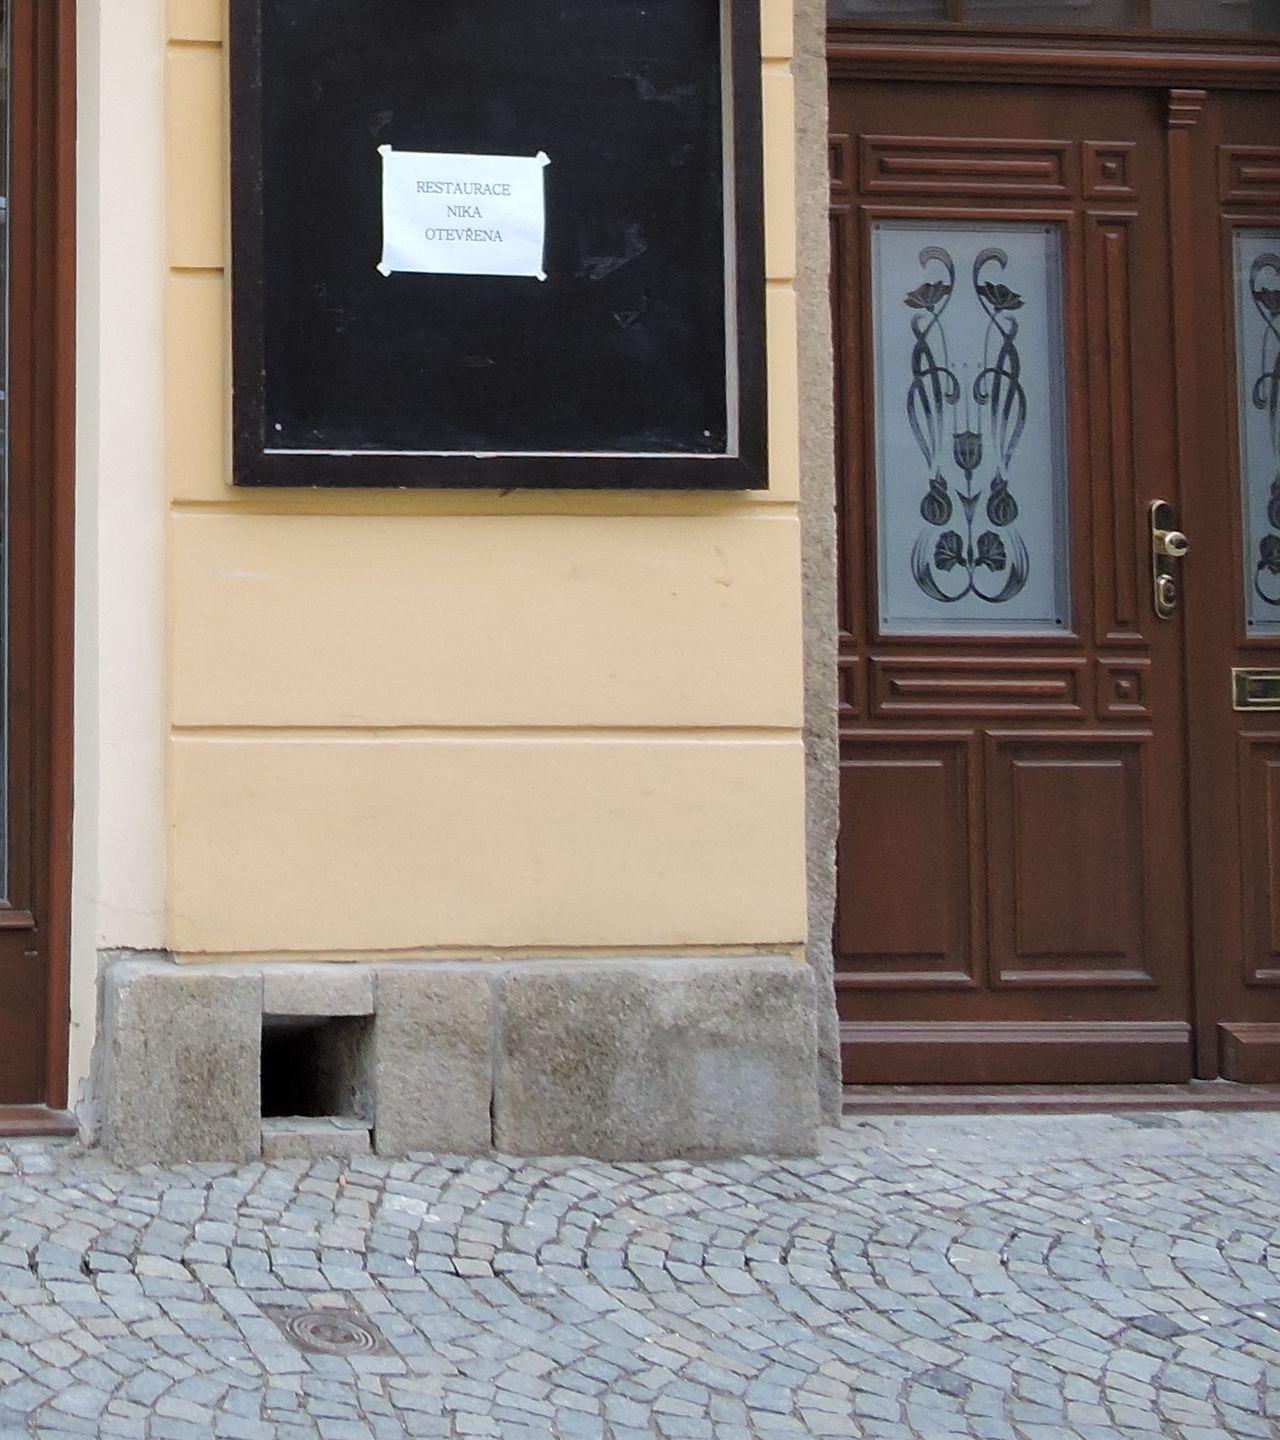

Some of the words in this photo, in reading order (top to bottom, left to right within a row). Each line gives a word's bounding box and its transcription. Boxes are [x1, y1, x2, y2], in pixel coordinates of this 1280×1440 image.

[416, 180, 512, 197] RESTAURACE
[446, 205, 483, 219] NIKA
[424, 227, 504, 243] OTEVŘENA
